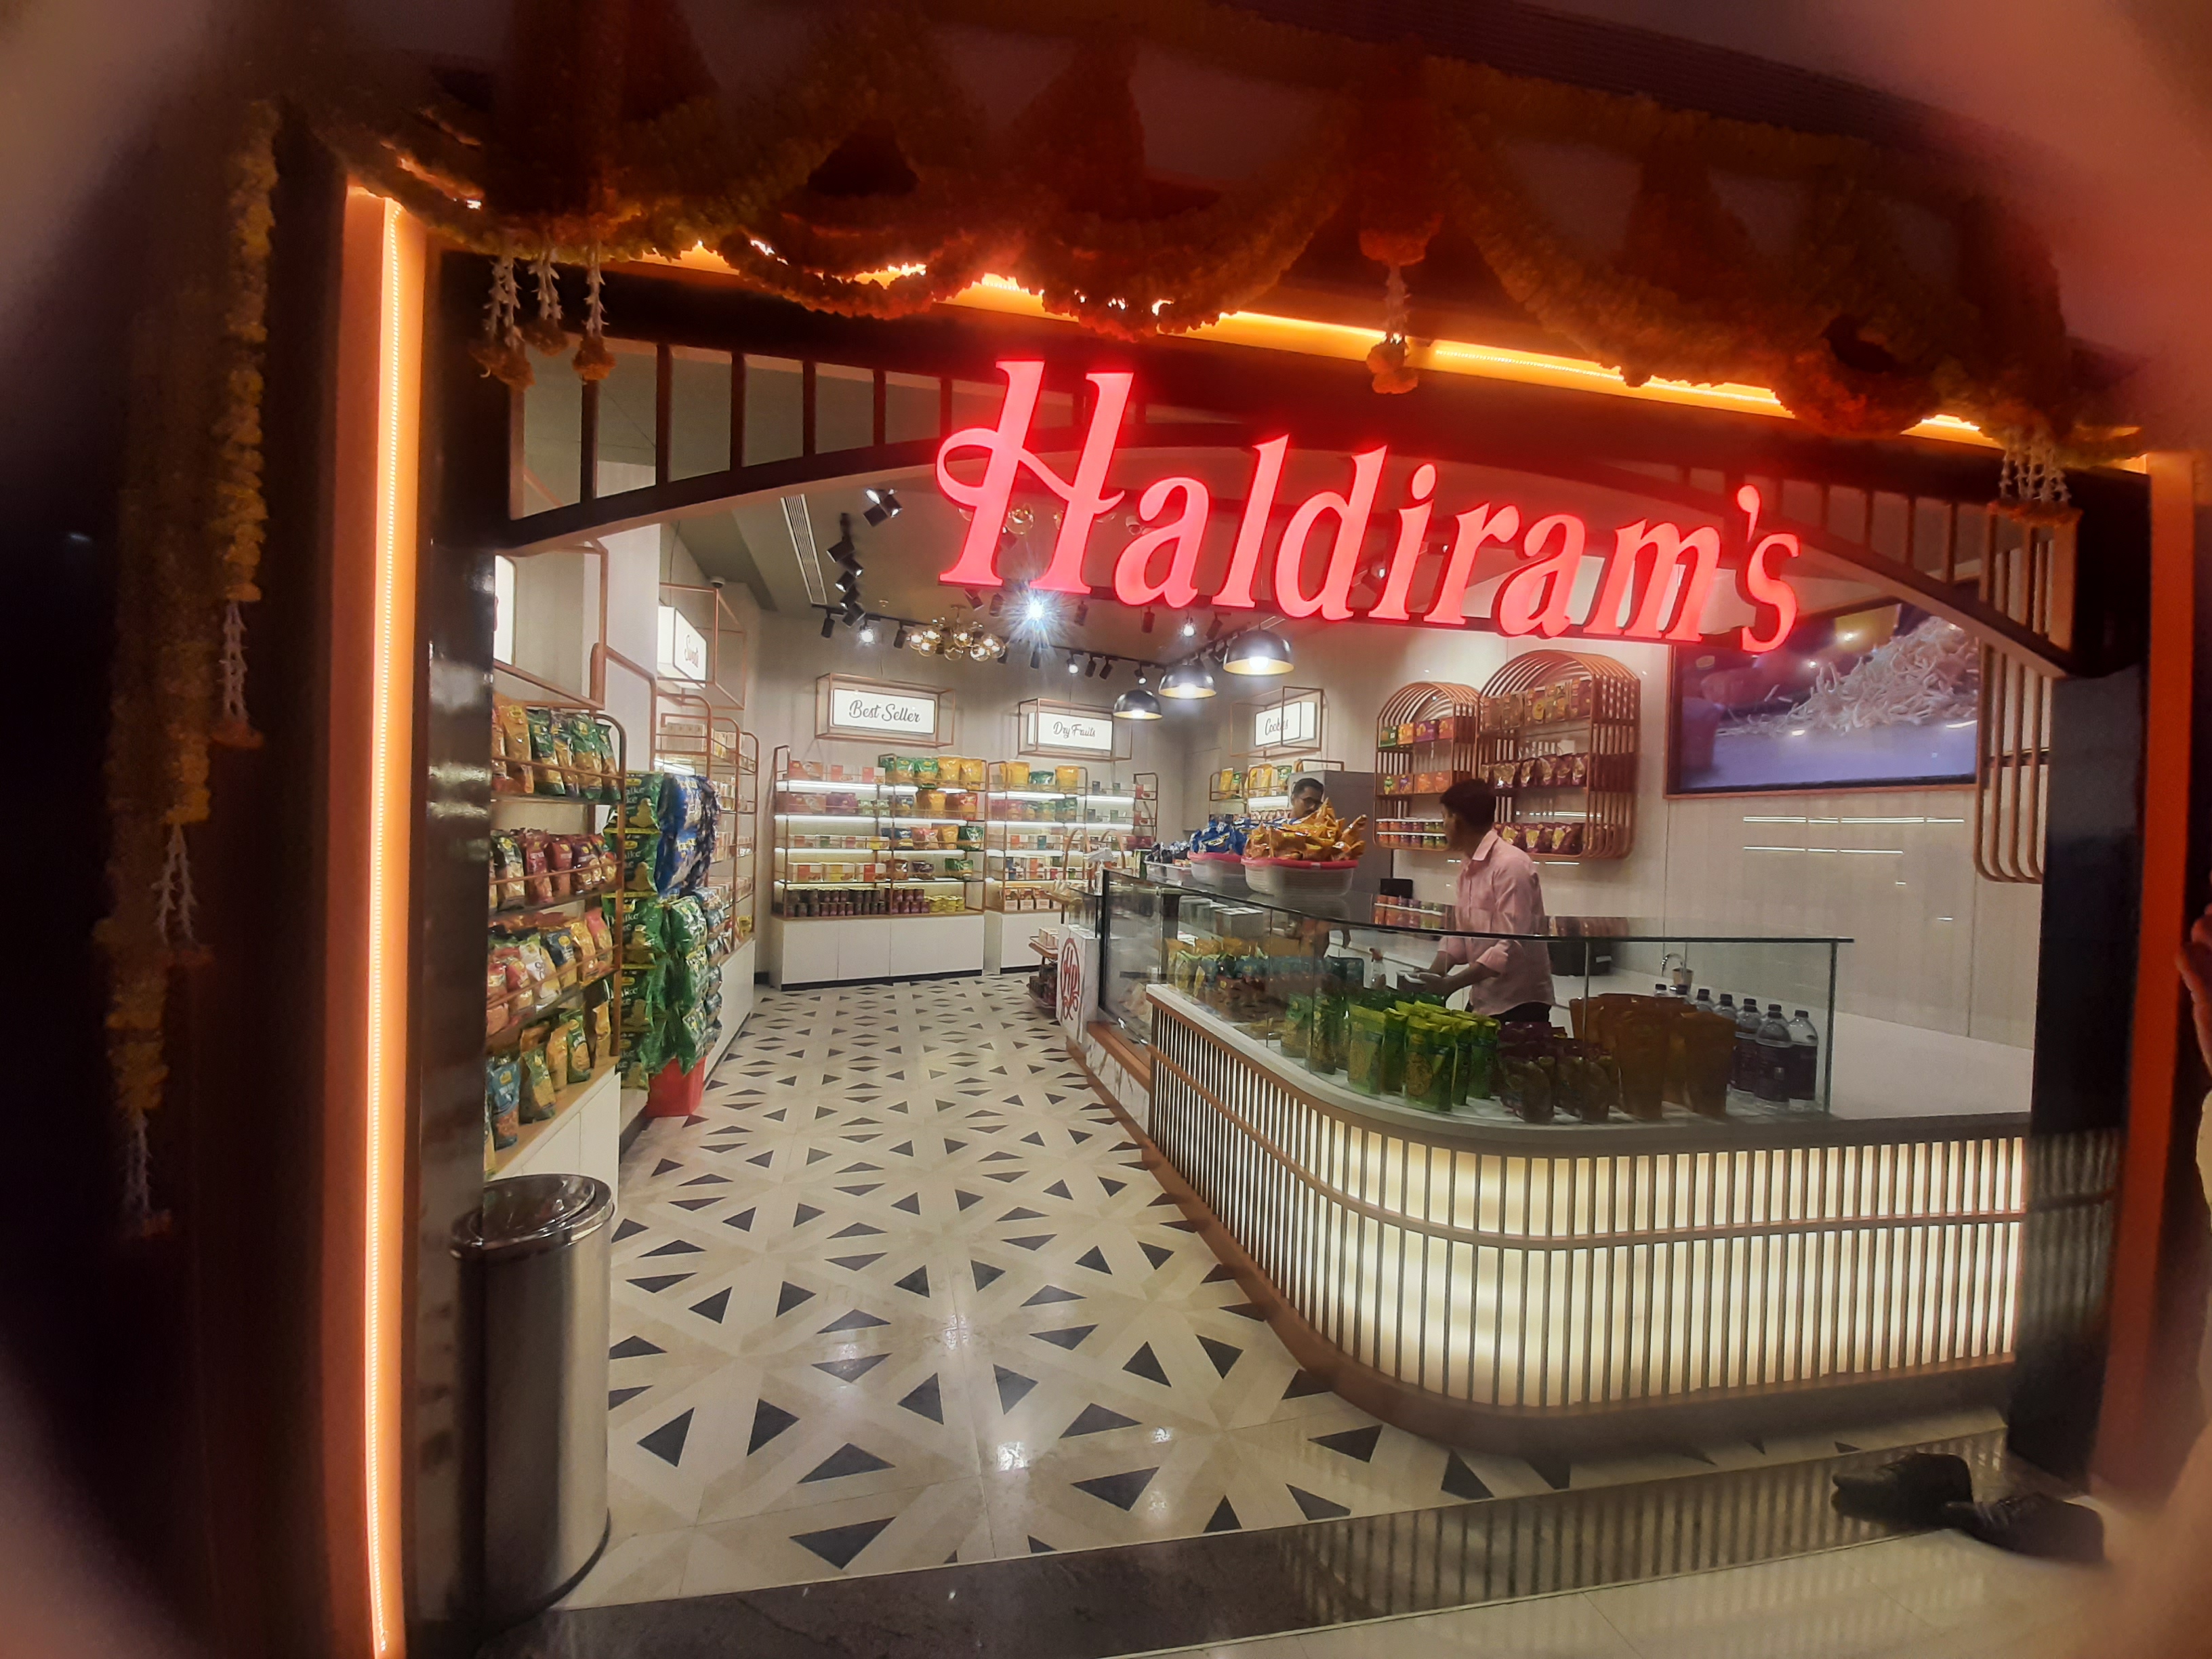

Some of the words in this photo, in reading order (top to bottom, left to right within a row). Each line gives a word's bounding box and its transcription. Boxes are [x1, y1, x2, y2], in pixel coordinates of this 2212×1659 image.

[935, 359, 1801, 653] Haldiram's
[848, 699, 881, 718] Best
[882, 703, 920, 722] Seller
[1053, 721, 1070, 739] Dry
[1071, 723, 1096, 737] Fruits
